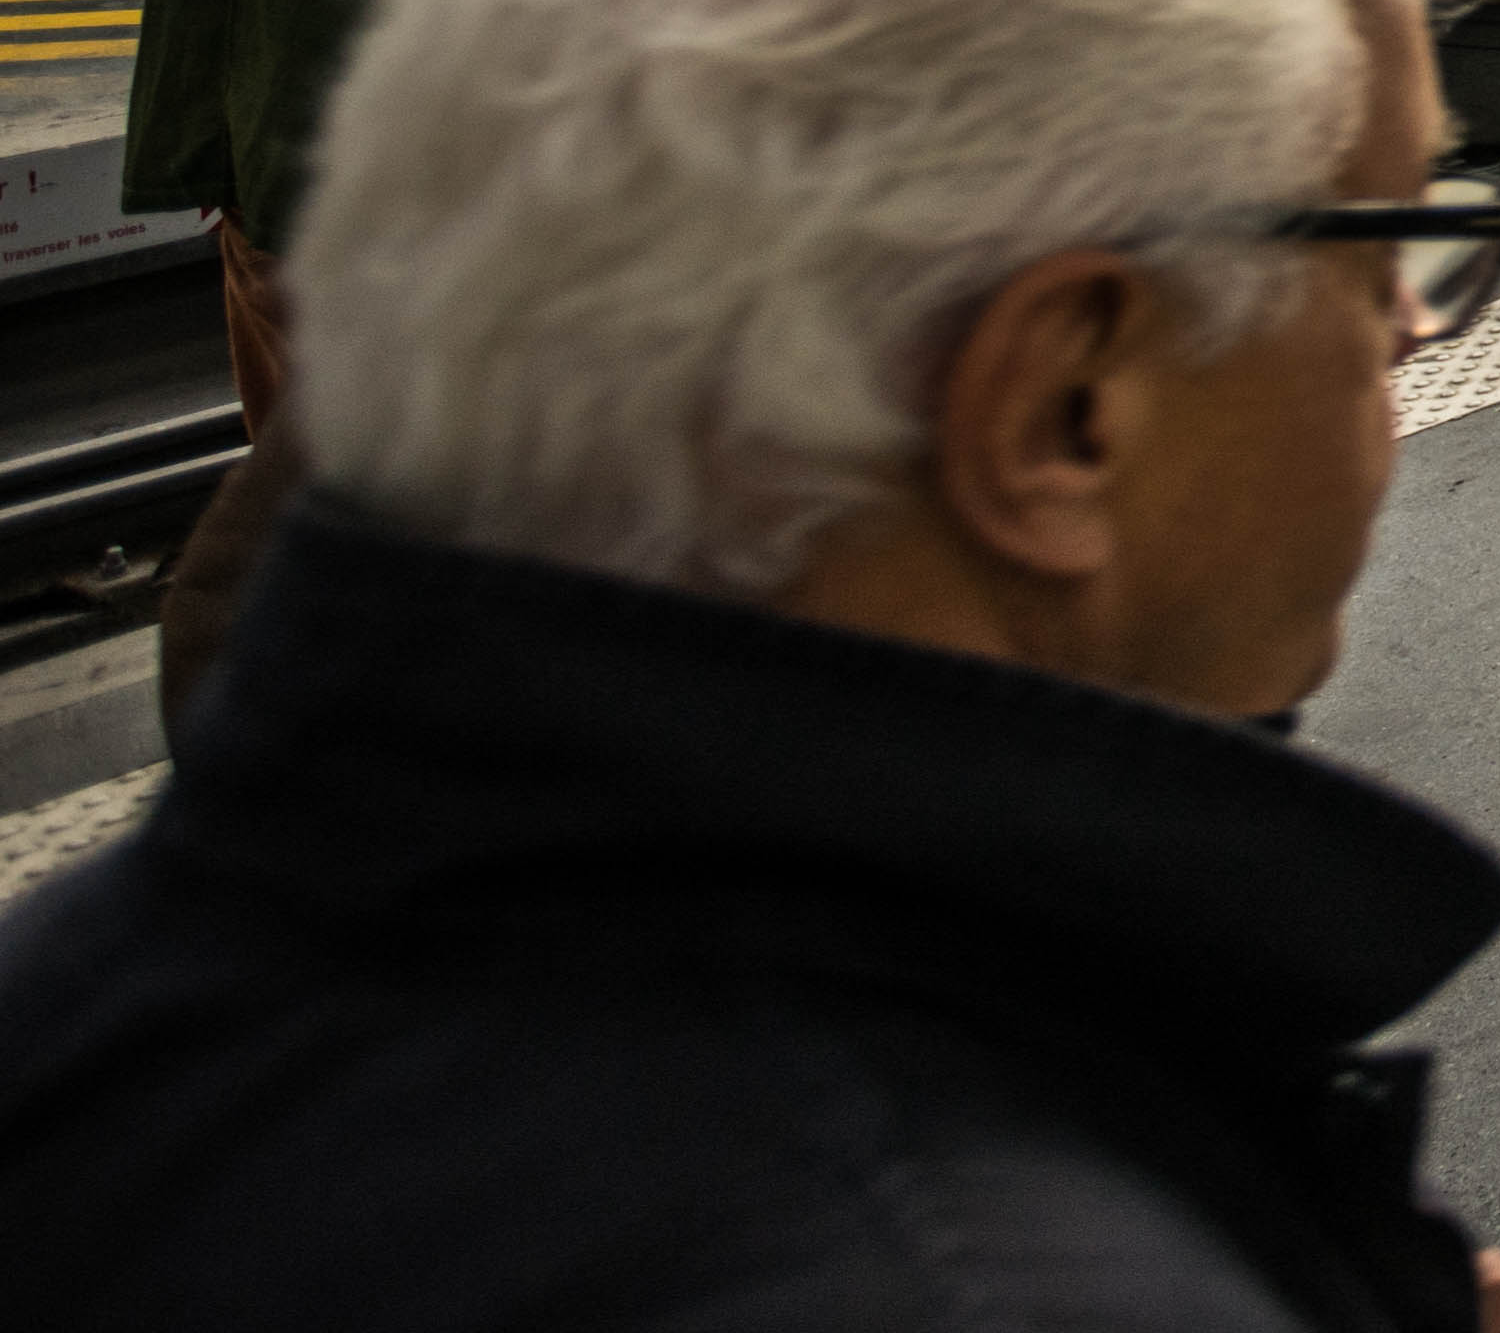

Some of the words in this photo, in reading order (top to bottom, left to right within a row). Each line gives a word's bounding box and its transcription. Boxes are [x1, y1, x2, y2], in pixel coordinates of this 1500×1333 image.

[4, 239, 72, 263] traverser
[78, 233, 100, 246] les
[108, 222, 146, 239] voies
